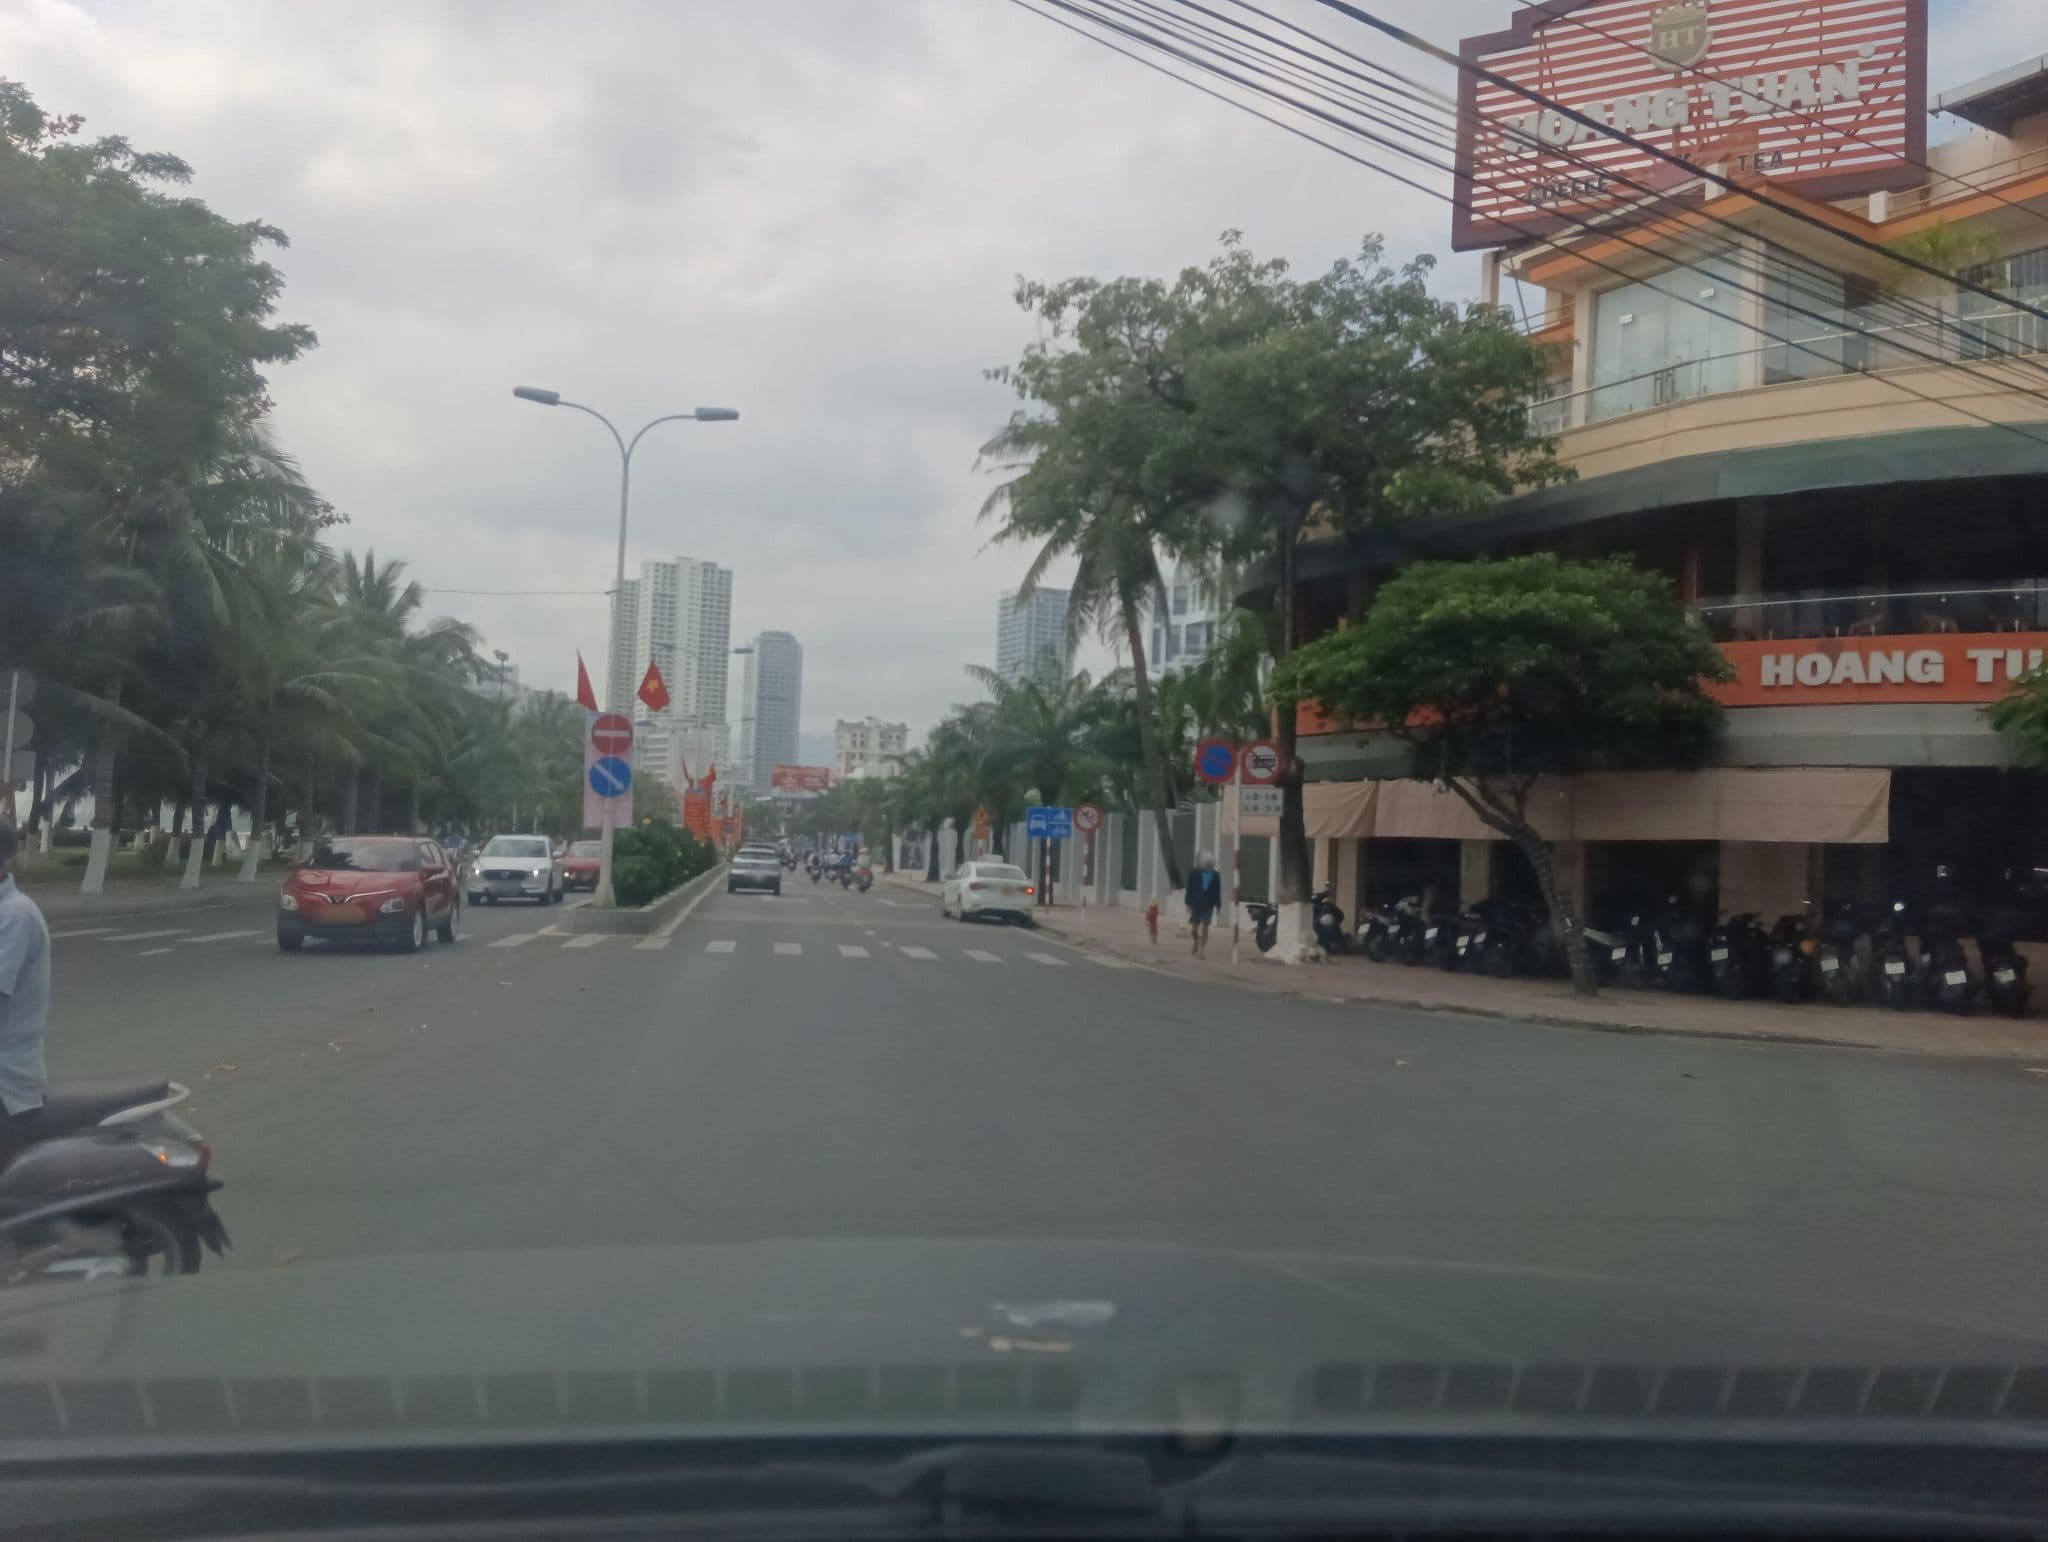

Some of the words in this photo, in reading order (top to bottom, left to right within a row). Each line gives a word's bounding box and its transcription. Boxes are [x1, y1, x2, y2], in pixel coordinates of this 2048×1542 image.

[1503, 87, 1689, 154] HOANG
[1702, 60, 1860, 121] TUAN
[1736, 149, 1784, 172] TEA
[1760, 650, 1945, 687] HOANG
